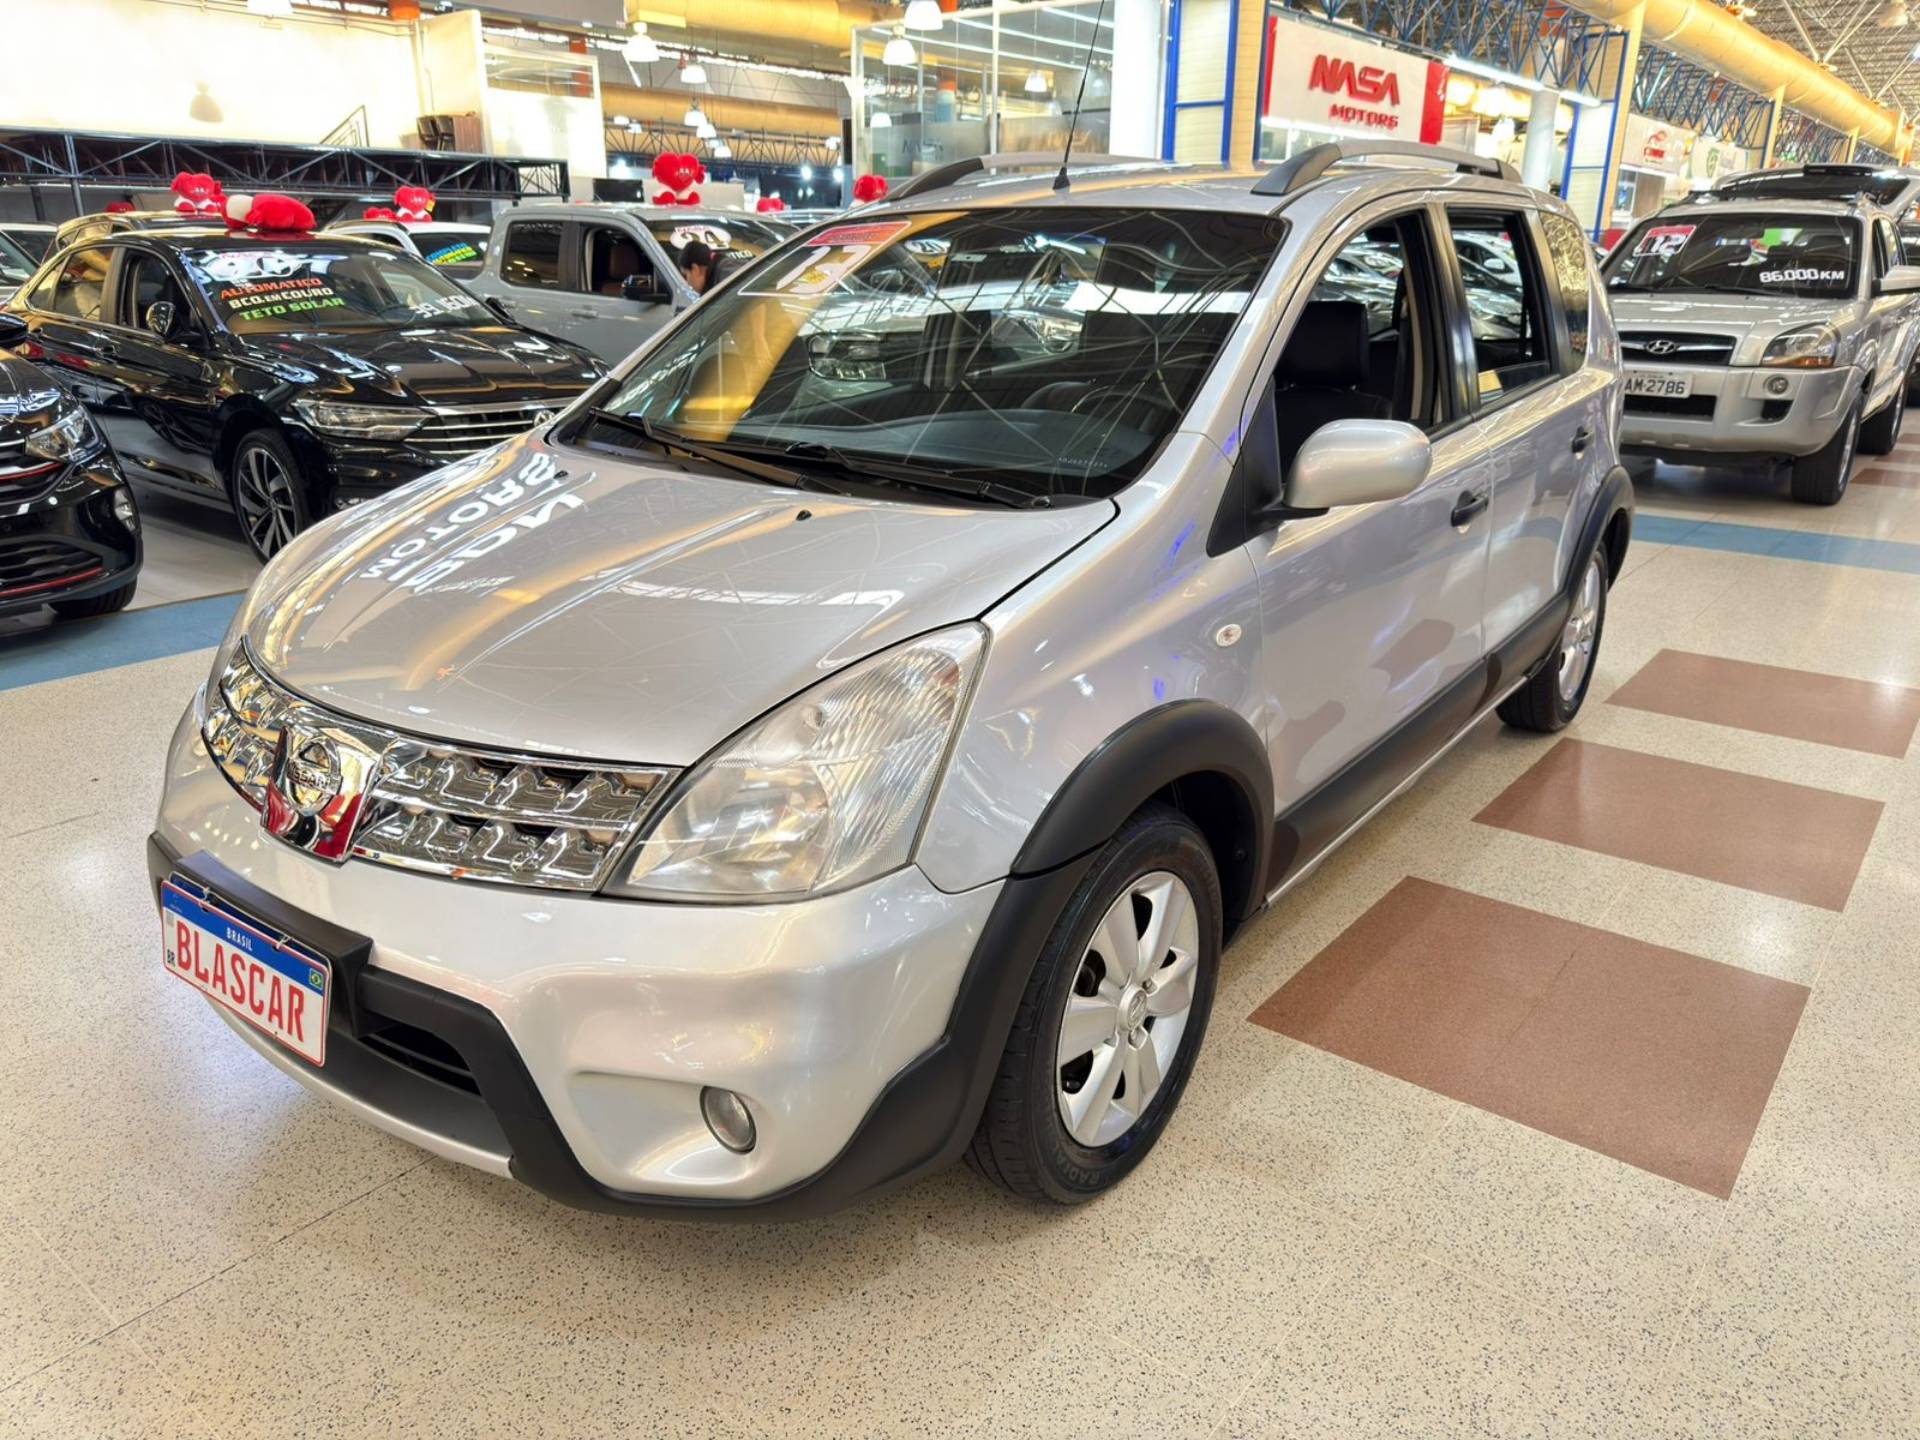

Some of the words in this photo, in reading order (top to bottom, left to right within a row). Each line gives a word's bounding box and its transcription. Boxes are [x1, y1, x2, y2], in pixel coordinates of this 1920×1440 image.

[1308, 54, 1400, 106] NASA
[1330, 104, 1399, 130] MOTORS
[239, 304, 287, 320] TETO
[288, 297, 345, 312] SOLAR
[226, 926, 253, 951] BRASIL
[166, 948, 177, 967] BR
[176, 920, 305, 1043] BLASCAR
